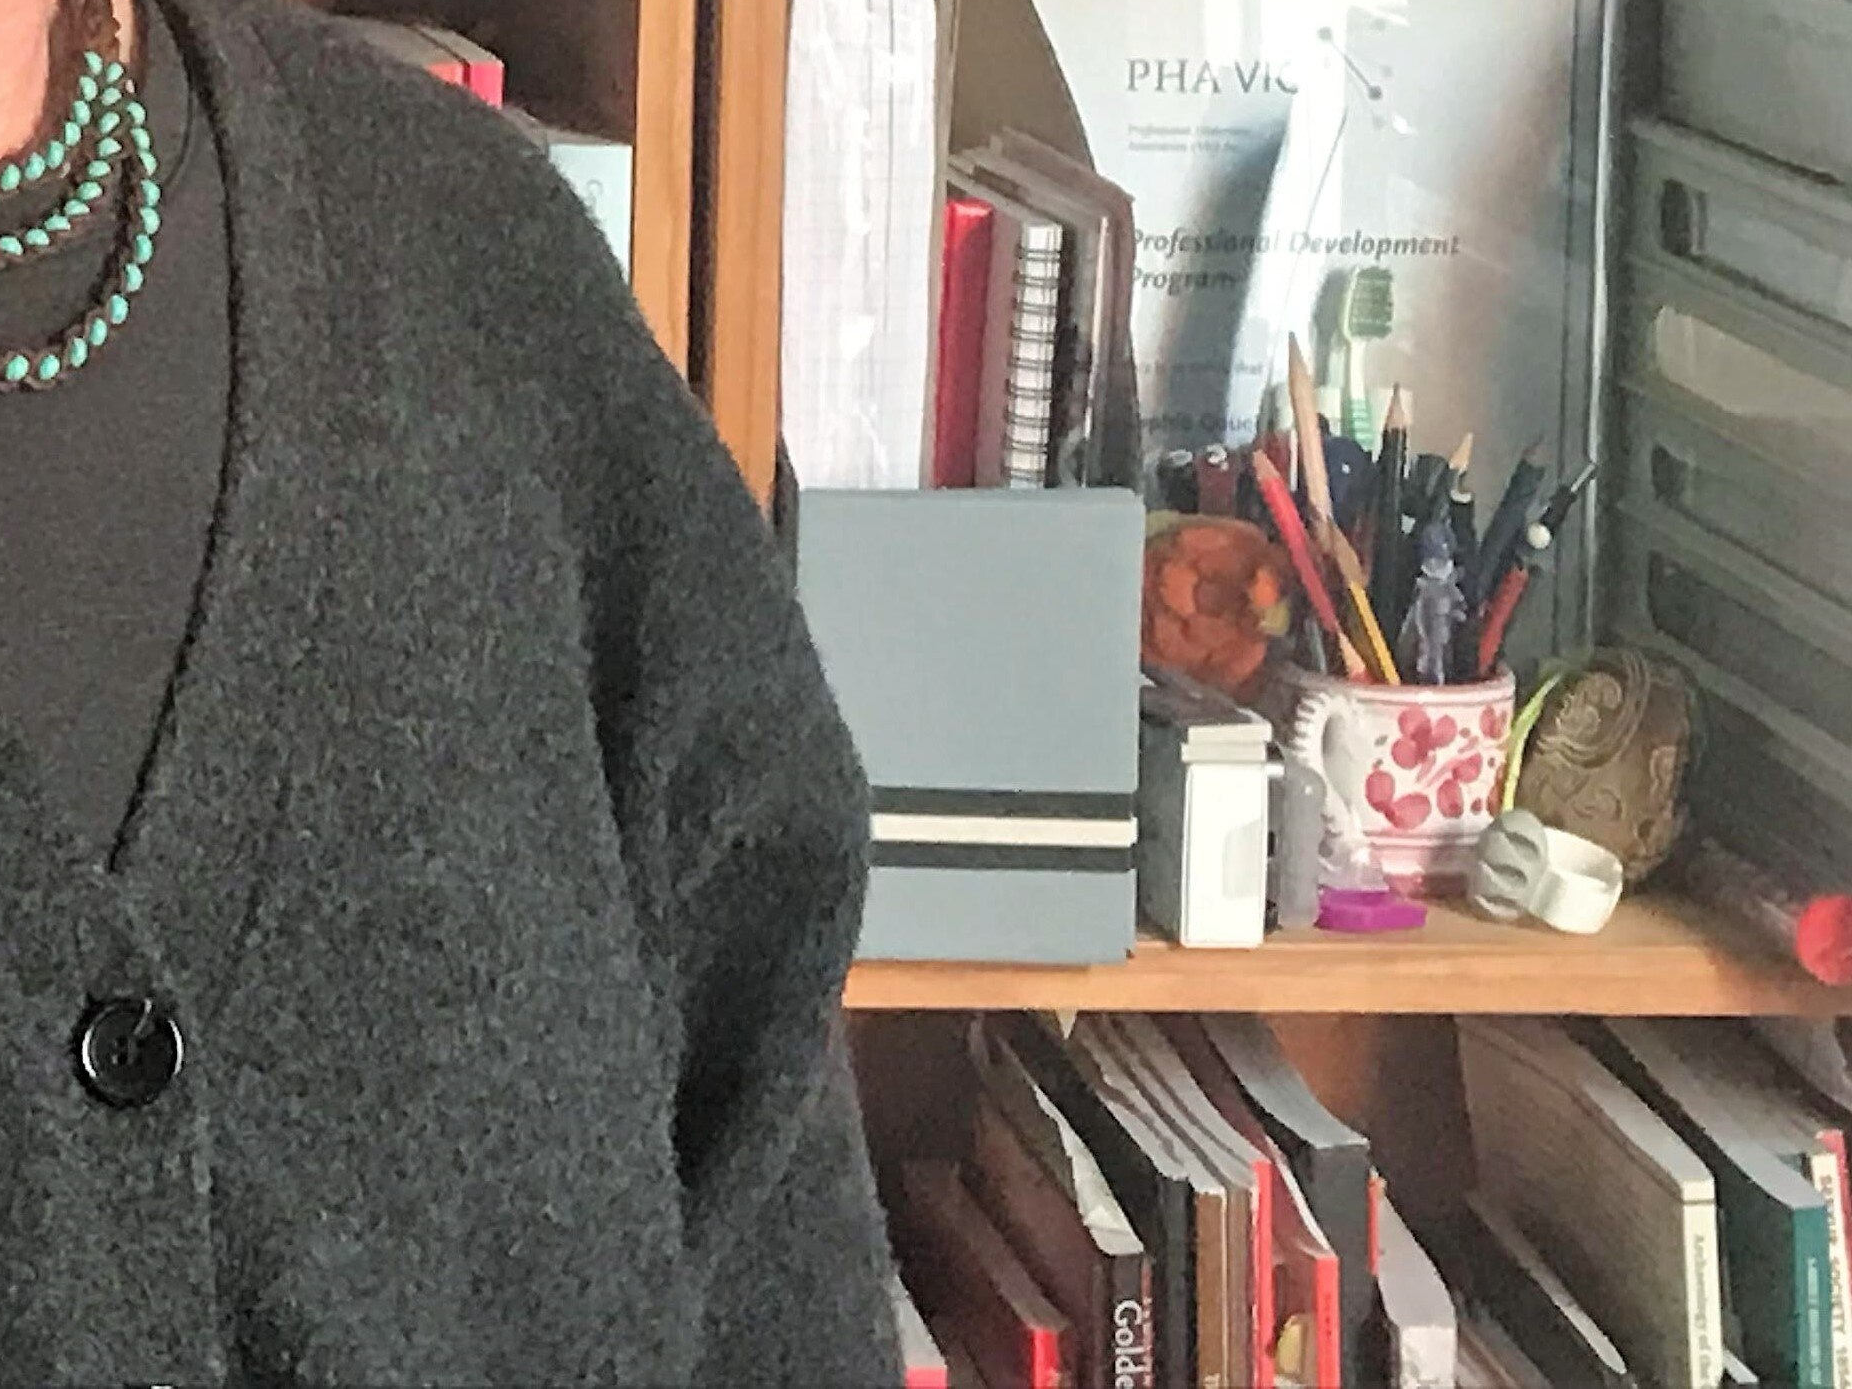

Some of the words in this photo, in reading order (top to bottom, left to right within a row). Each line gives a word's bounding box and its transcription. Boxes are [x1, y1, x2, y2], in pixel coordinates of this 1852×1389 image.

[1125, 58, 1221, 94] PHA
[1133, 227, 1279, 260] Professional
[1288, 228, 1462, 261] Development
